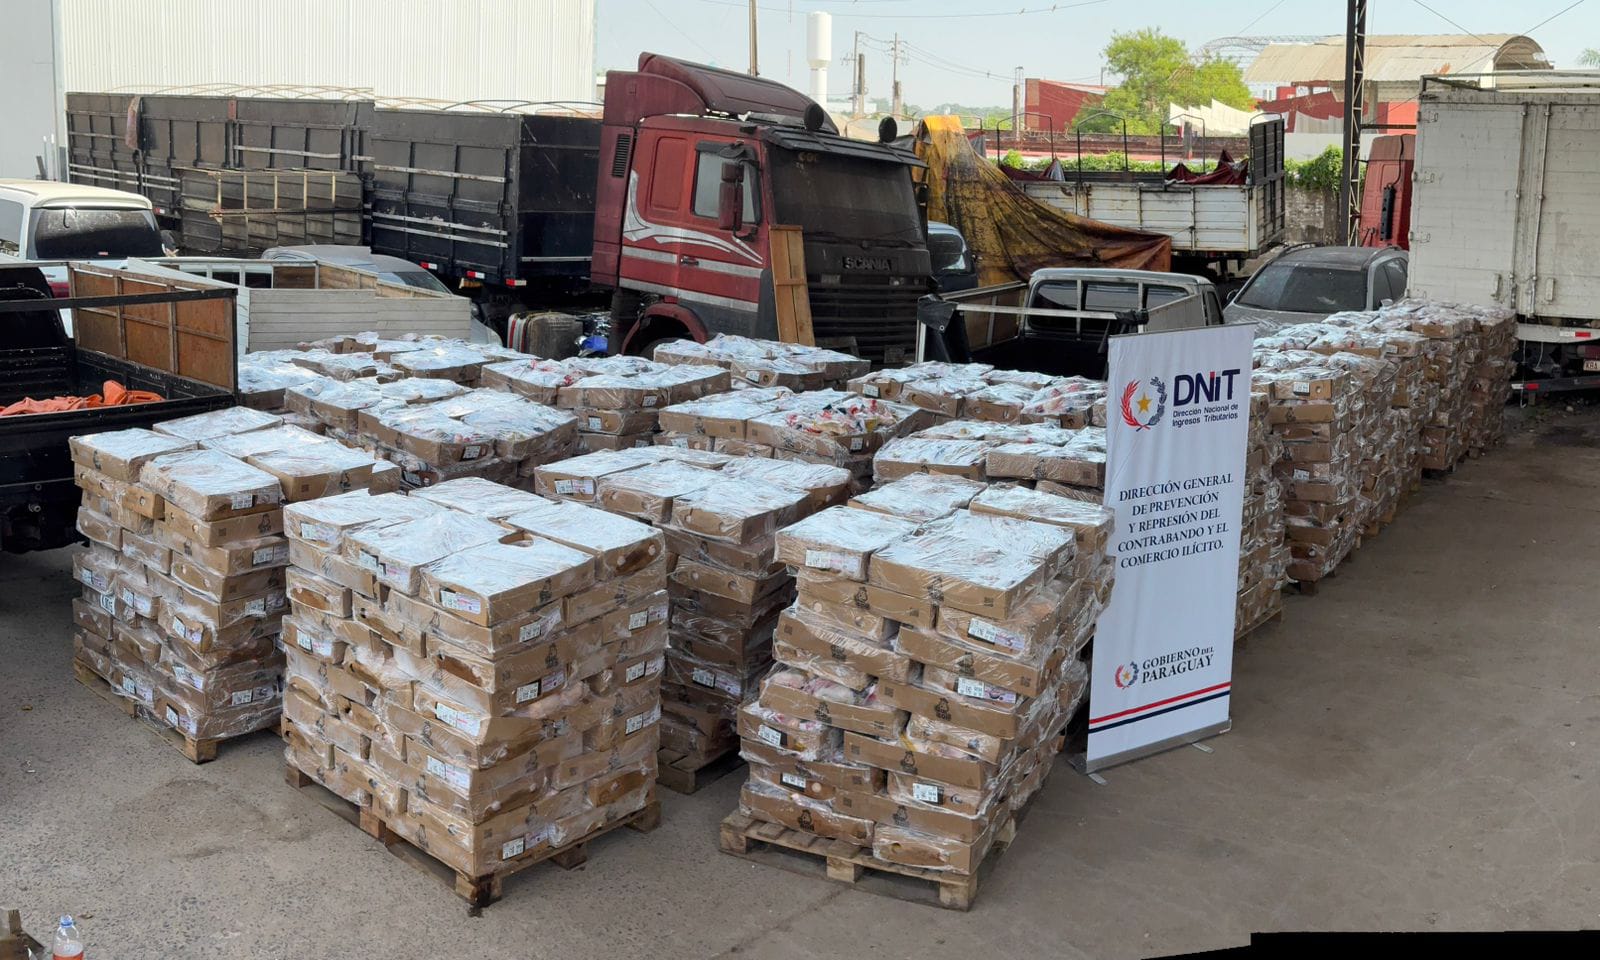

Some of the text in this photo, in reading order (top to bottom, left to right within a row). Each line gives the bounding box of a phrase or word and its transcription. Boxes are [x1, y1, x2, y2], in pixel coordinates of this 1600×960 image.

[845, 256, 890, 271] SCANIA
[1173, 412, 1238, 428] Ingresos Tributarios
[1204, 404, 1229, 414] Nacional
[1120, 473, 1234, 501] DIRECCIÓN GENERAL
[1132, 490, 1219, 516] DE PREVENCIÓN
[1129, 508, 1220, 534] Y REPRESIÓN DEL
[1118, 522, 1229, 553] CONTRABANDO Y EL
[1120, 539, 1224, 569] COMERCIO ILÍCITO.
[1142, 646, 1214, 670] GOBIERNO DEL
[1142, 653, 1214, 684] PARAGUAY
